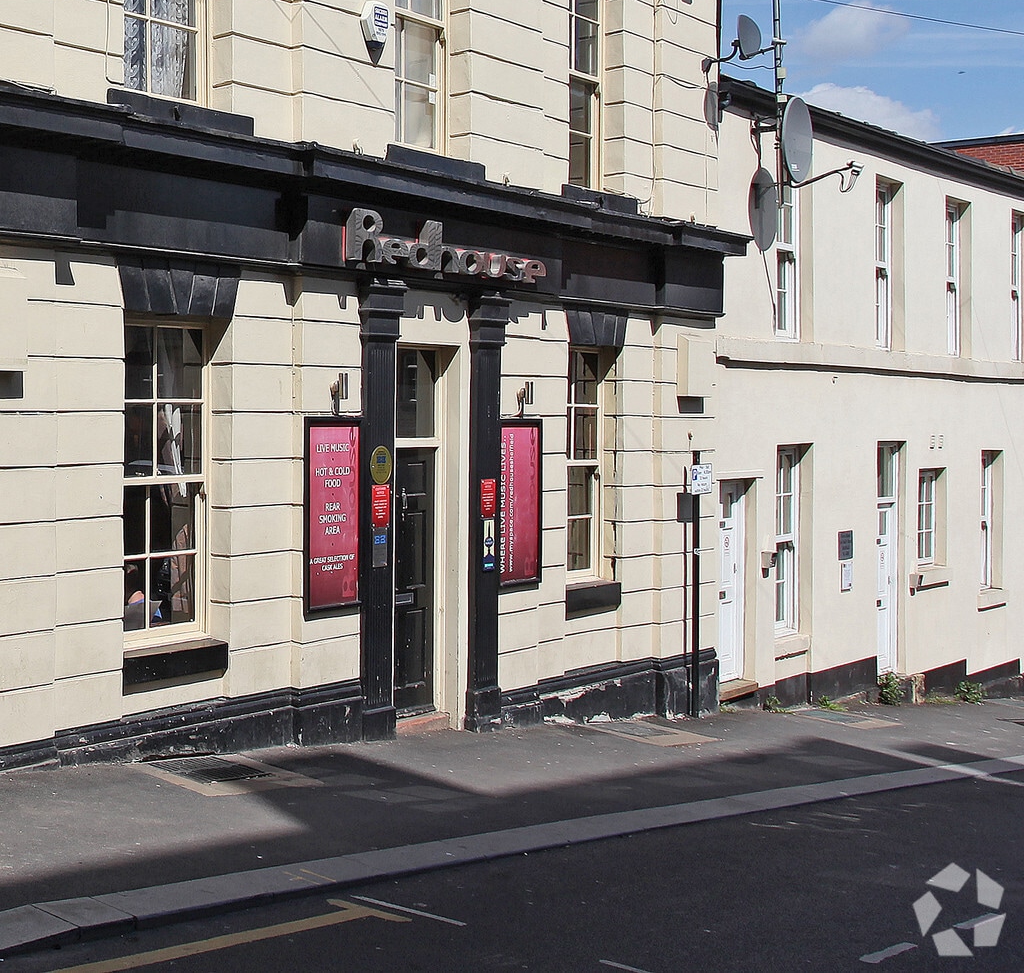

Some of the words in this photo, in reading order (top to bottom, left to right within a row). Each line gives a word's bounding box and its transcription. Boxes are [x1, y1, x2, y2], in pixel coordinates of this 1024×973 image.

[346, 207, 547, 285] Redhouse
[316, 443, 330, 453] LIVE
[330, 443, 350, 452] MUSIC
[315, 467, 327, 477] HOT
[328, 467, 334, 476] &
[334, 466, 351, 476] COLD
[324, 478, 342, 488] FOOD
[325, 502, 341, 512] REAR
[319, 513, 347, 524] SMOKING
[324, 525, 341, 536] AREA
[313, 556, 327, 565] GREAT
[327, 554, 349, 563] SELECTION
